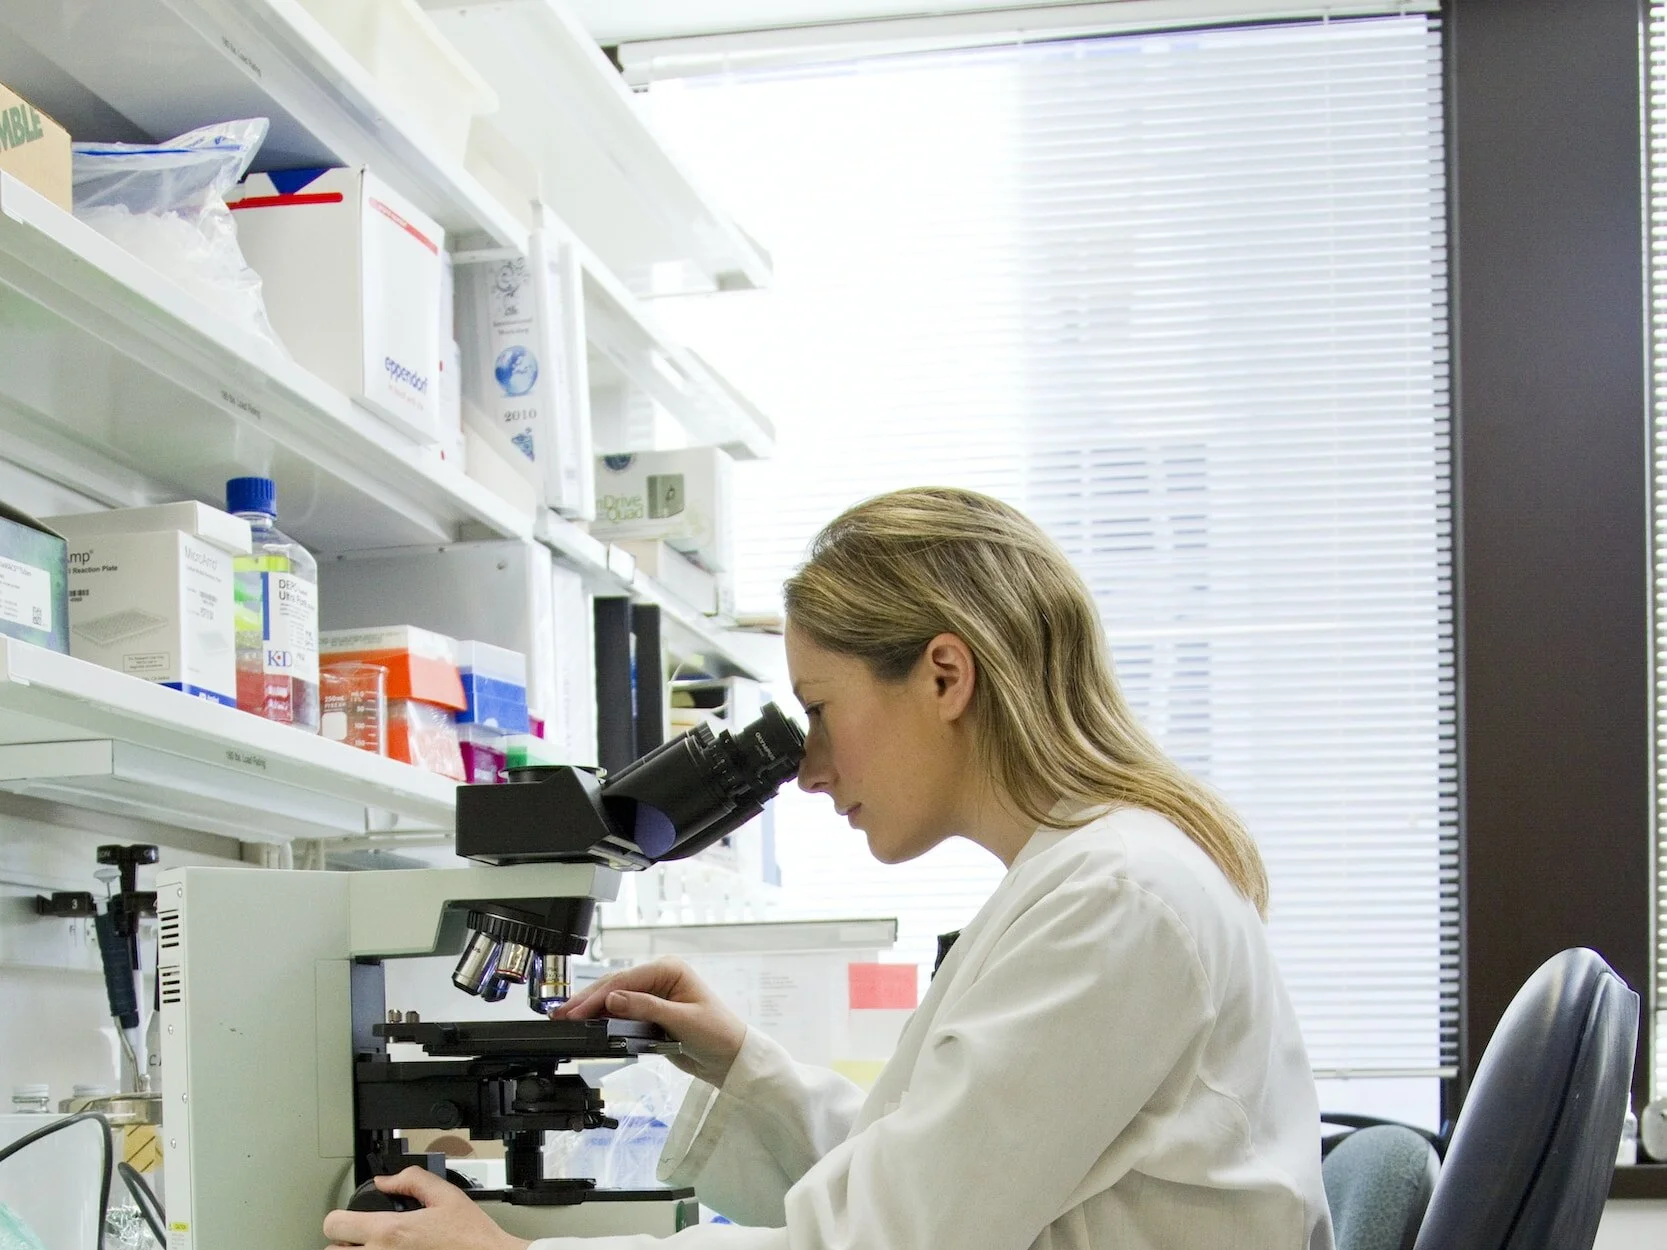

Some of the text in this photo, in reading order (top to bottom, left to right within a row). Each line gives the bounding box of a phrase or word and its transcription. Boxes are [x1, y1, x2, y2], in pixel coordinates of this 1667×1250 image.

[385, 357, 428, 395] eppendorf
[504, 409, 537, 422] 2010
[72, 564, 118, 575] Reaction Plate
[72, 899, 78, 910] 3
